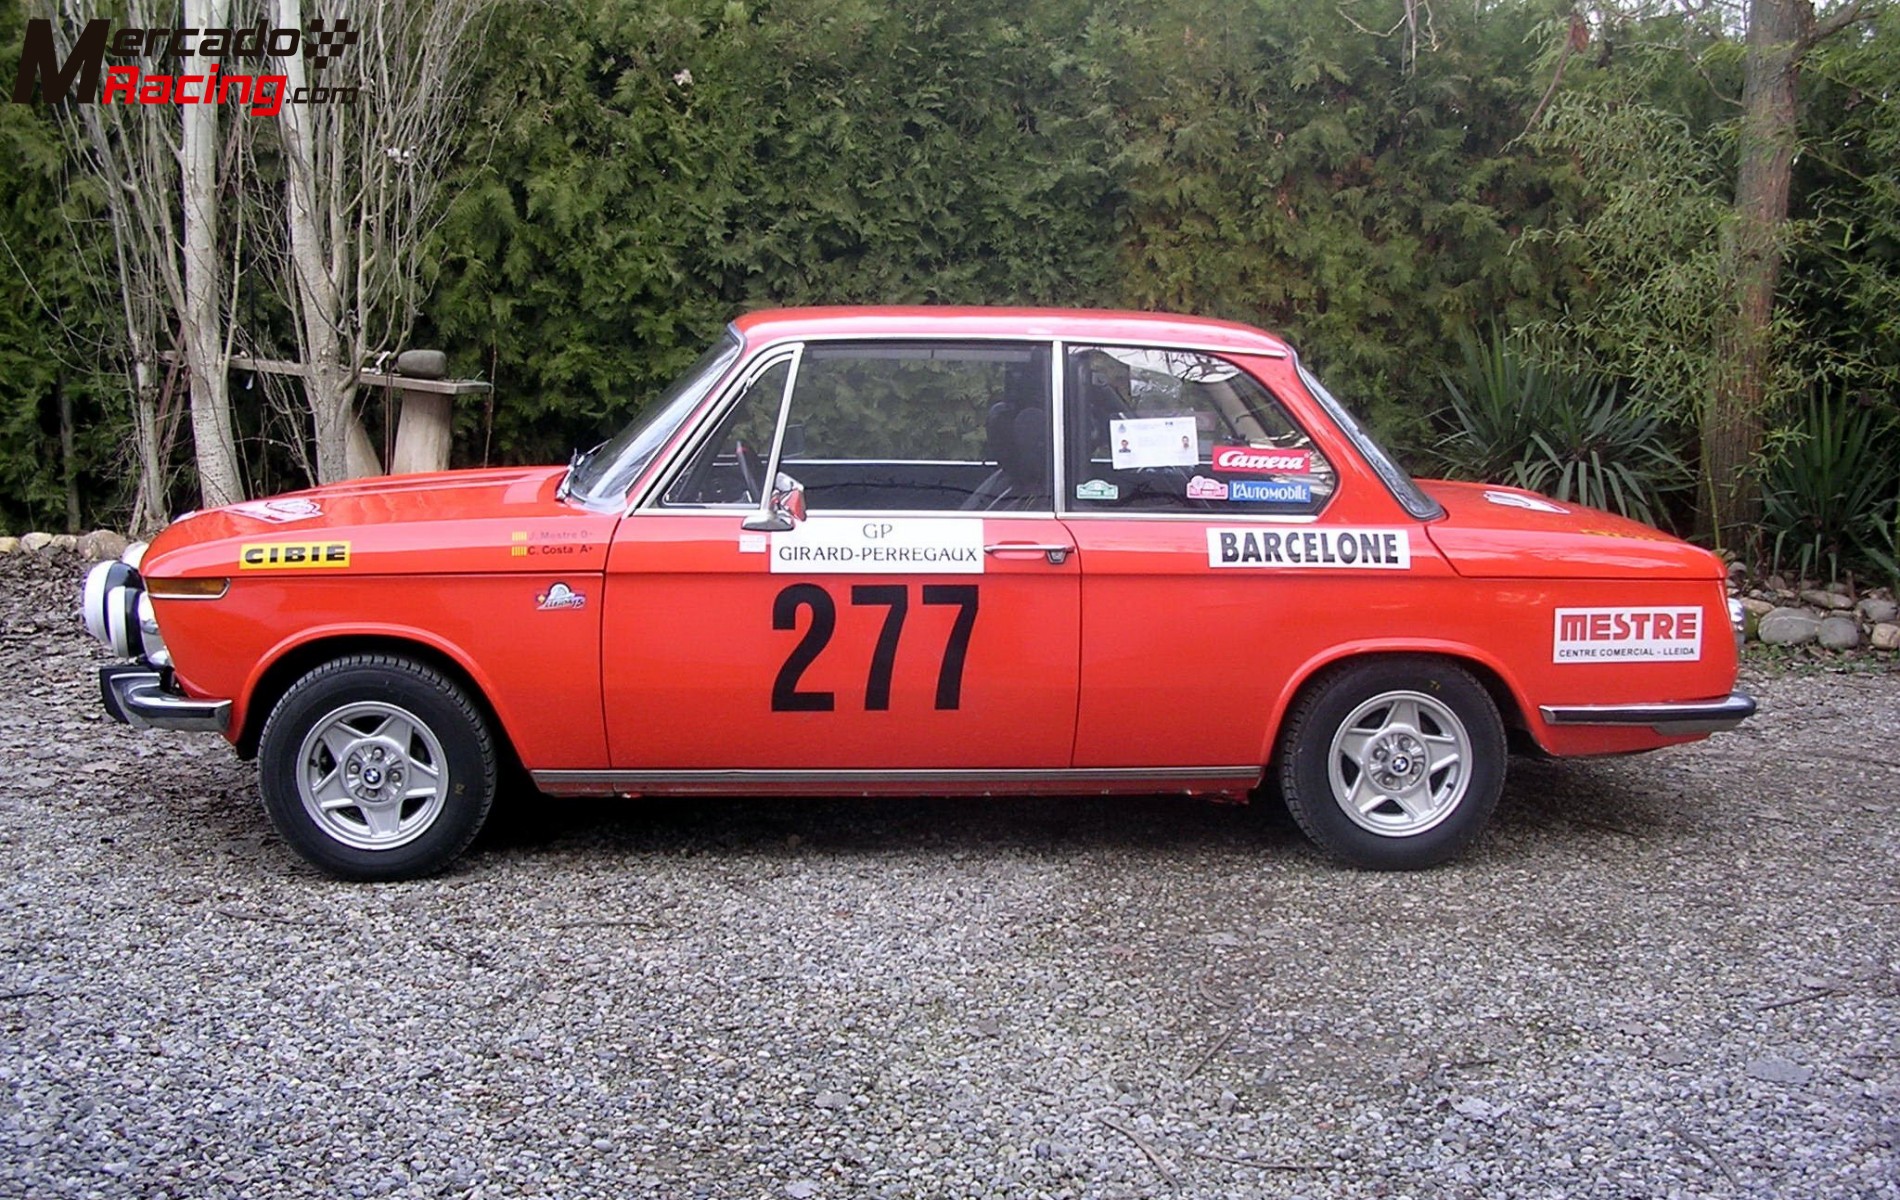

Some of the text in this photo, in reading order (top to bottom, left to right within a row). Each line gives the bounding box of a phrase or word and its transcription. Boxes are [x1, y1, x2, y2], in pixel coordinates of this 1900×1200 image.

[1218, 450, 1305, 470] Carrera
[862, 523, 893, 539] GP
[542, 545, 573, 555] Costa
[779, 546, 977, 561] GIRARD-PERREGAUX
[1220, 532, 1399, 564] BARCELONE
[1560, 613, 1697, 641] MESTRE
[771, 583, 979, 712] 277
[1559, 649, 1596, 657] CENTRE
[1600, 648, 1654, 656] COMERCIAL
[1663, 647, 1695, 655] LLEIDA
